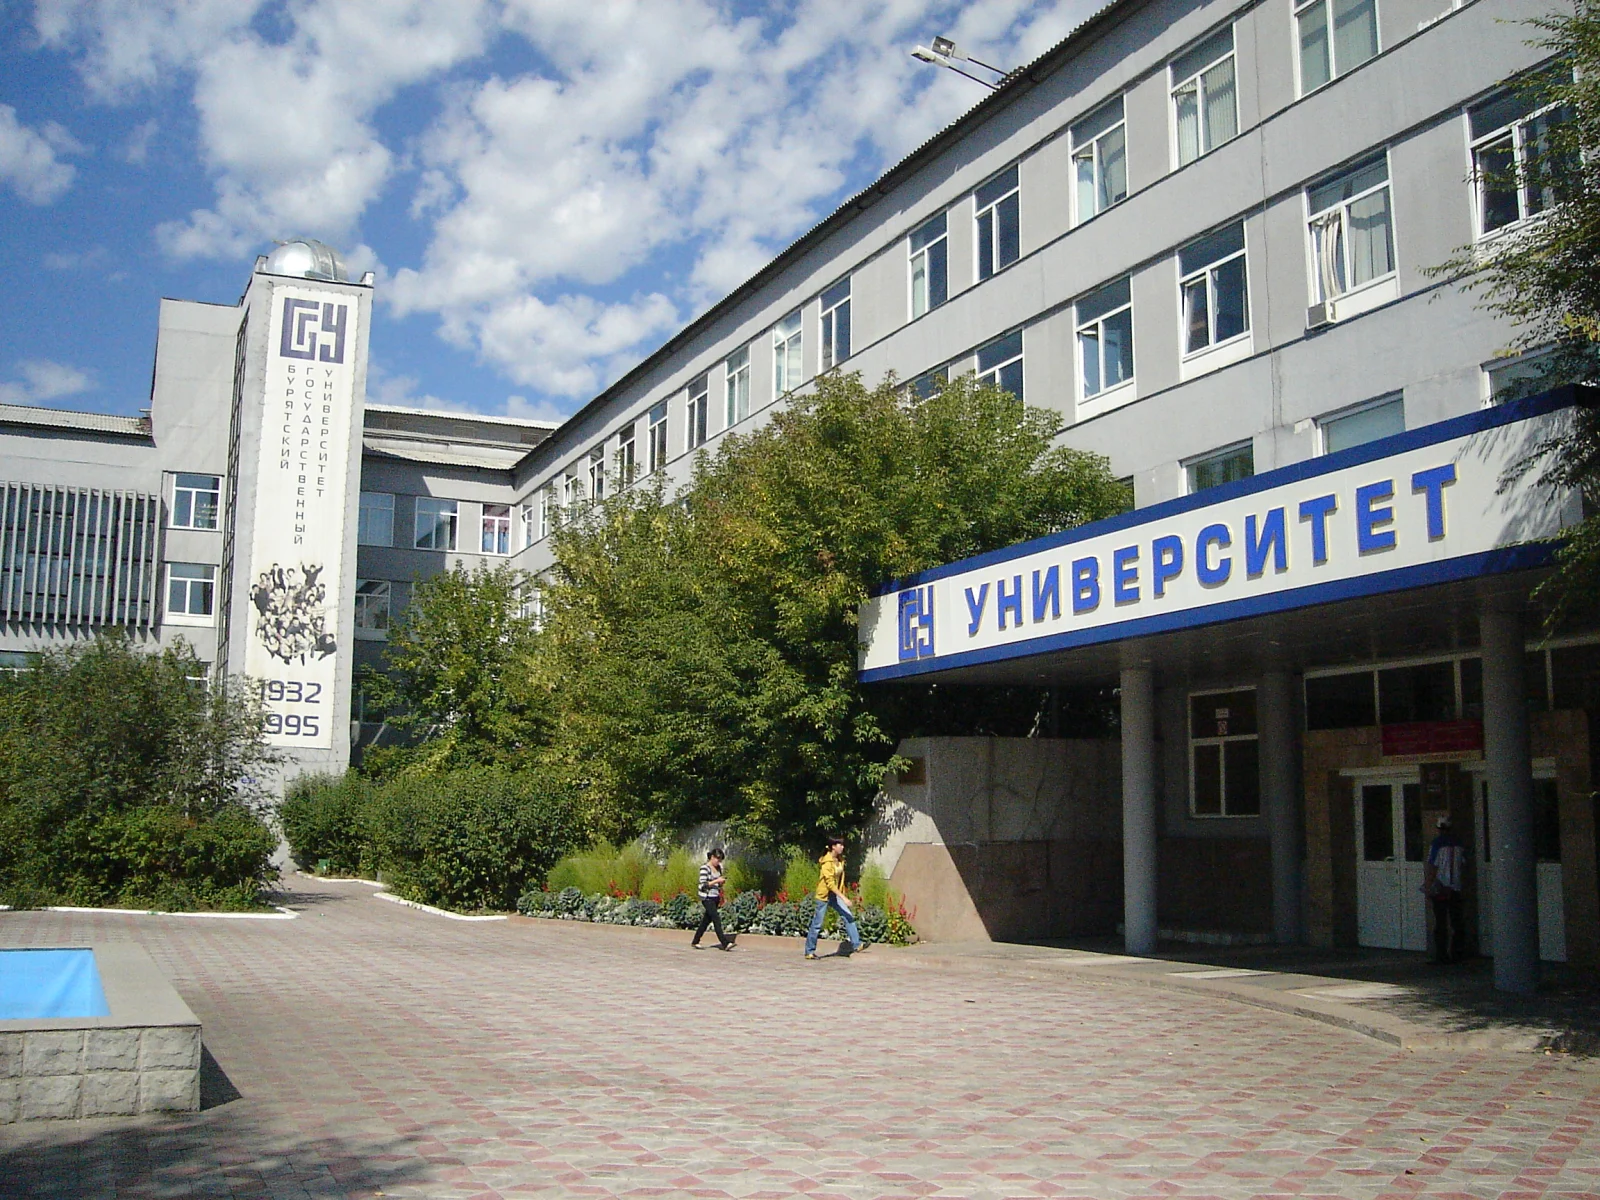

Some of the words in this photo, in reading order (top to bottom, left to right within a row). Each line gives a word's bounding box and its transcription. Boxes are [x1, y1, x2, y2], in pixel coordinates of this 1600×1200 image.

[280, 364, 296, 470] БУРЯТСКИЙ
[293, 366, 315, 545] ГОСУДАРСТВЕННЫЙ
[316, 369, 333, 498] УНИВЕРСИТЕТ
[964, 463, 1458, 636] УНИВЕРСИТЕТ
[258, 713, 320, 737] 995
